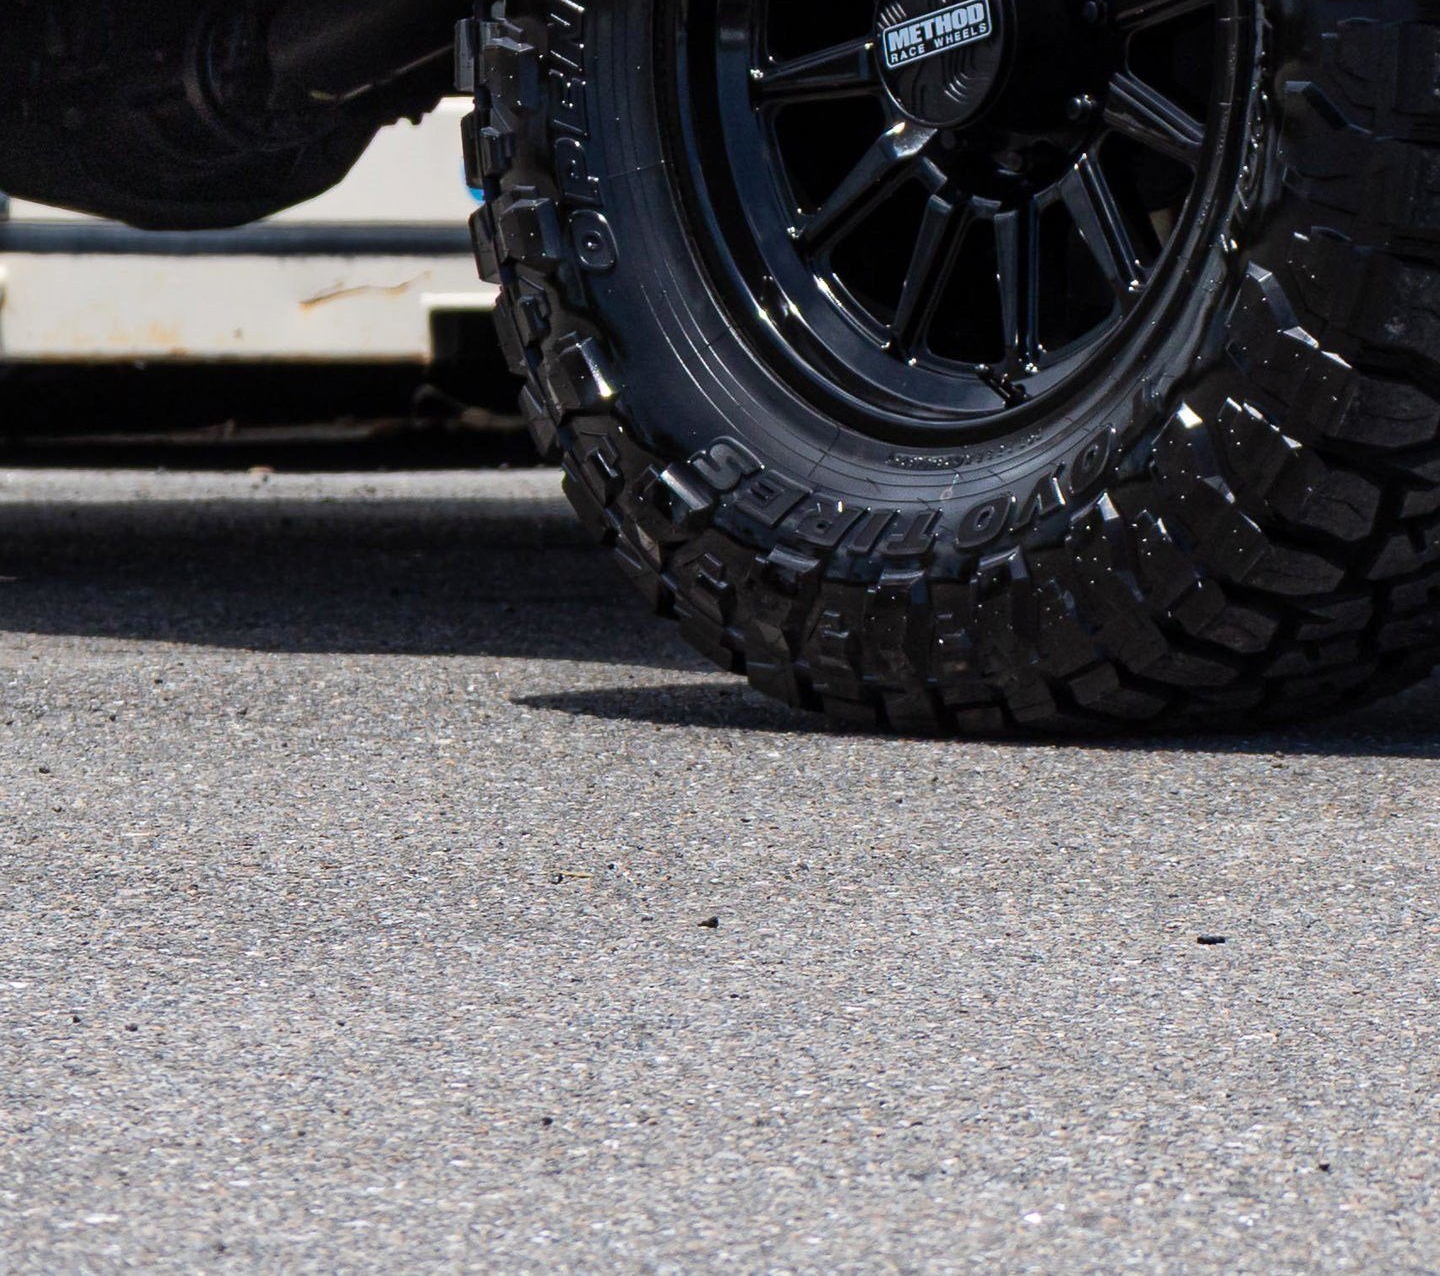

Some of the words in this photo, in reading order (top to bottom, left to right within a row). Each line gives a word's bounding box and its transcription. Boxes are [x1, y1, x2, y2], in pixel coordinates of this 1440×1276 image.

[888, 2, 985, 52] METHOD
[890, 45, 926, 63] RACE
[934, 23, 987, 49] WHEELS
[688, 435, 944, 558] TIRES
